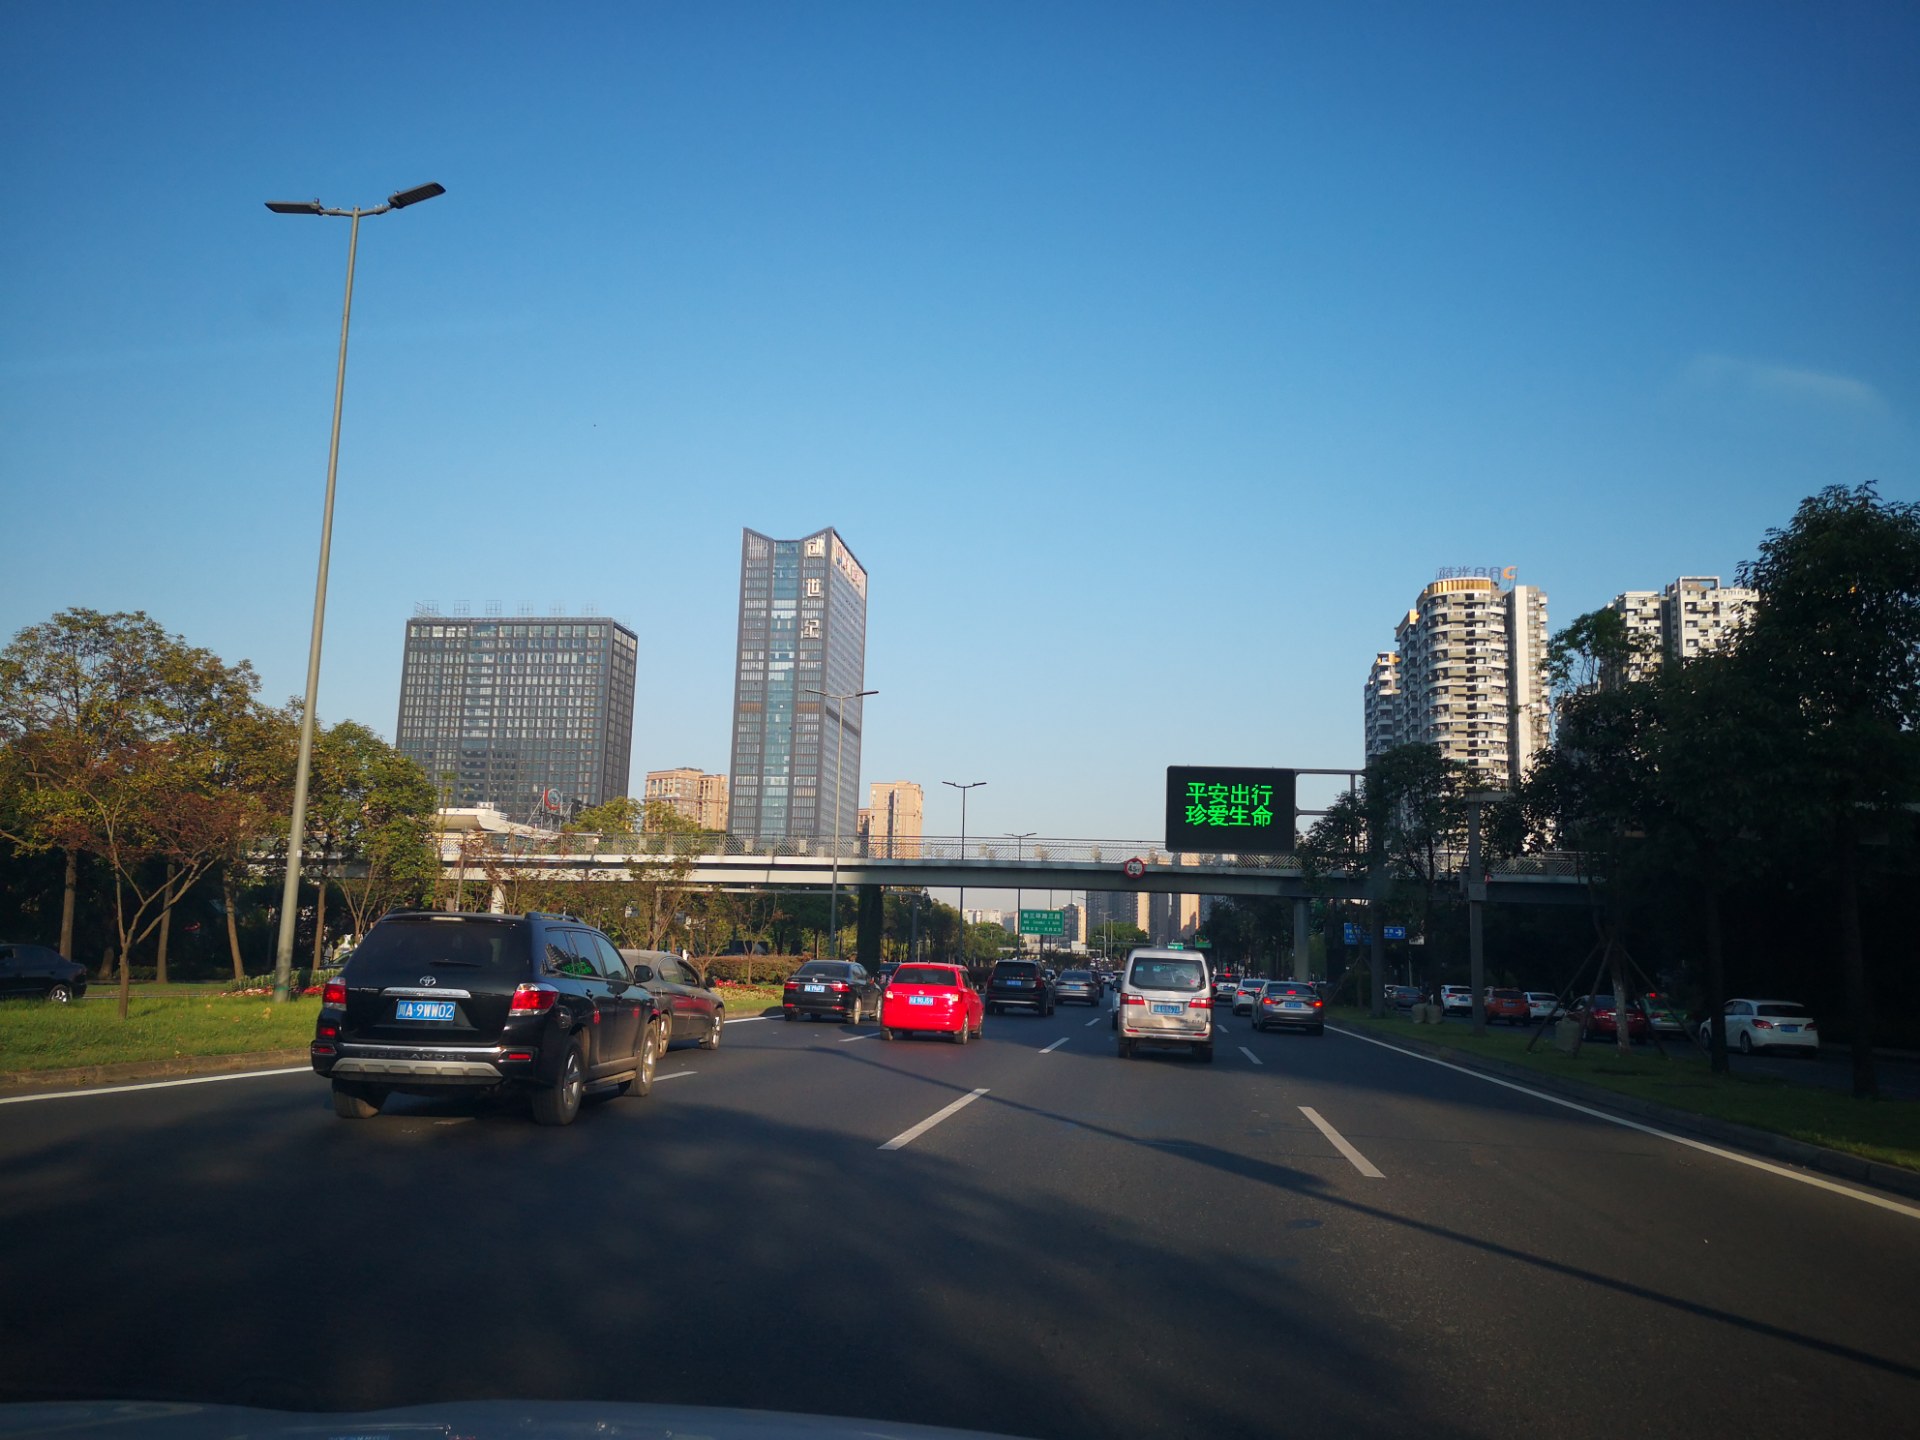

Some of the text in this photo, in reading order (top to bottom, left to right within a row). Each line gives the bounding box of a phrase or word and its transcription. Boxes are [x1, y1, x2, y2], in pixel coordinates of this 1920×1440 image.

[1185, 782, 1274, 805] 平安出行
[1185, 803, 1274, 827] 珍爱生命
[360, 1050, 467, 1061] HIGHLANDER
